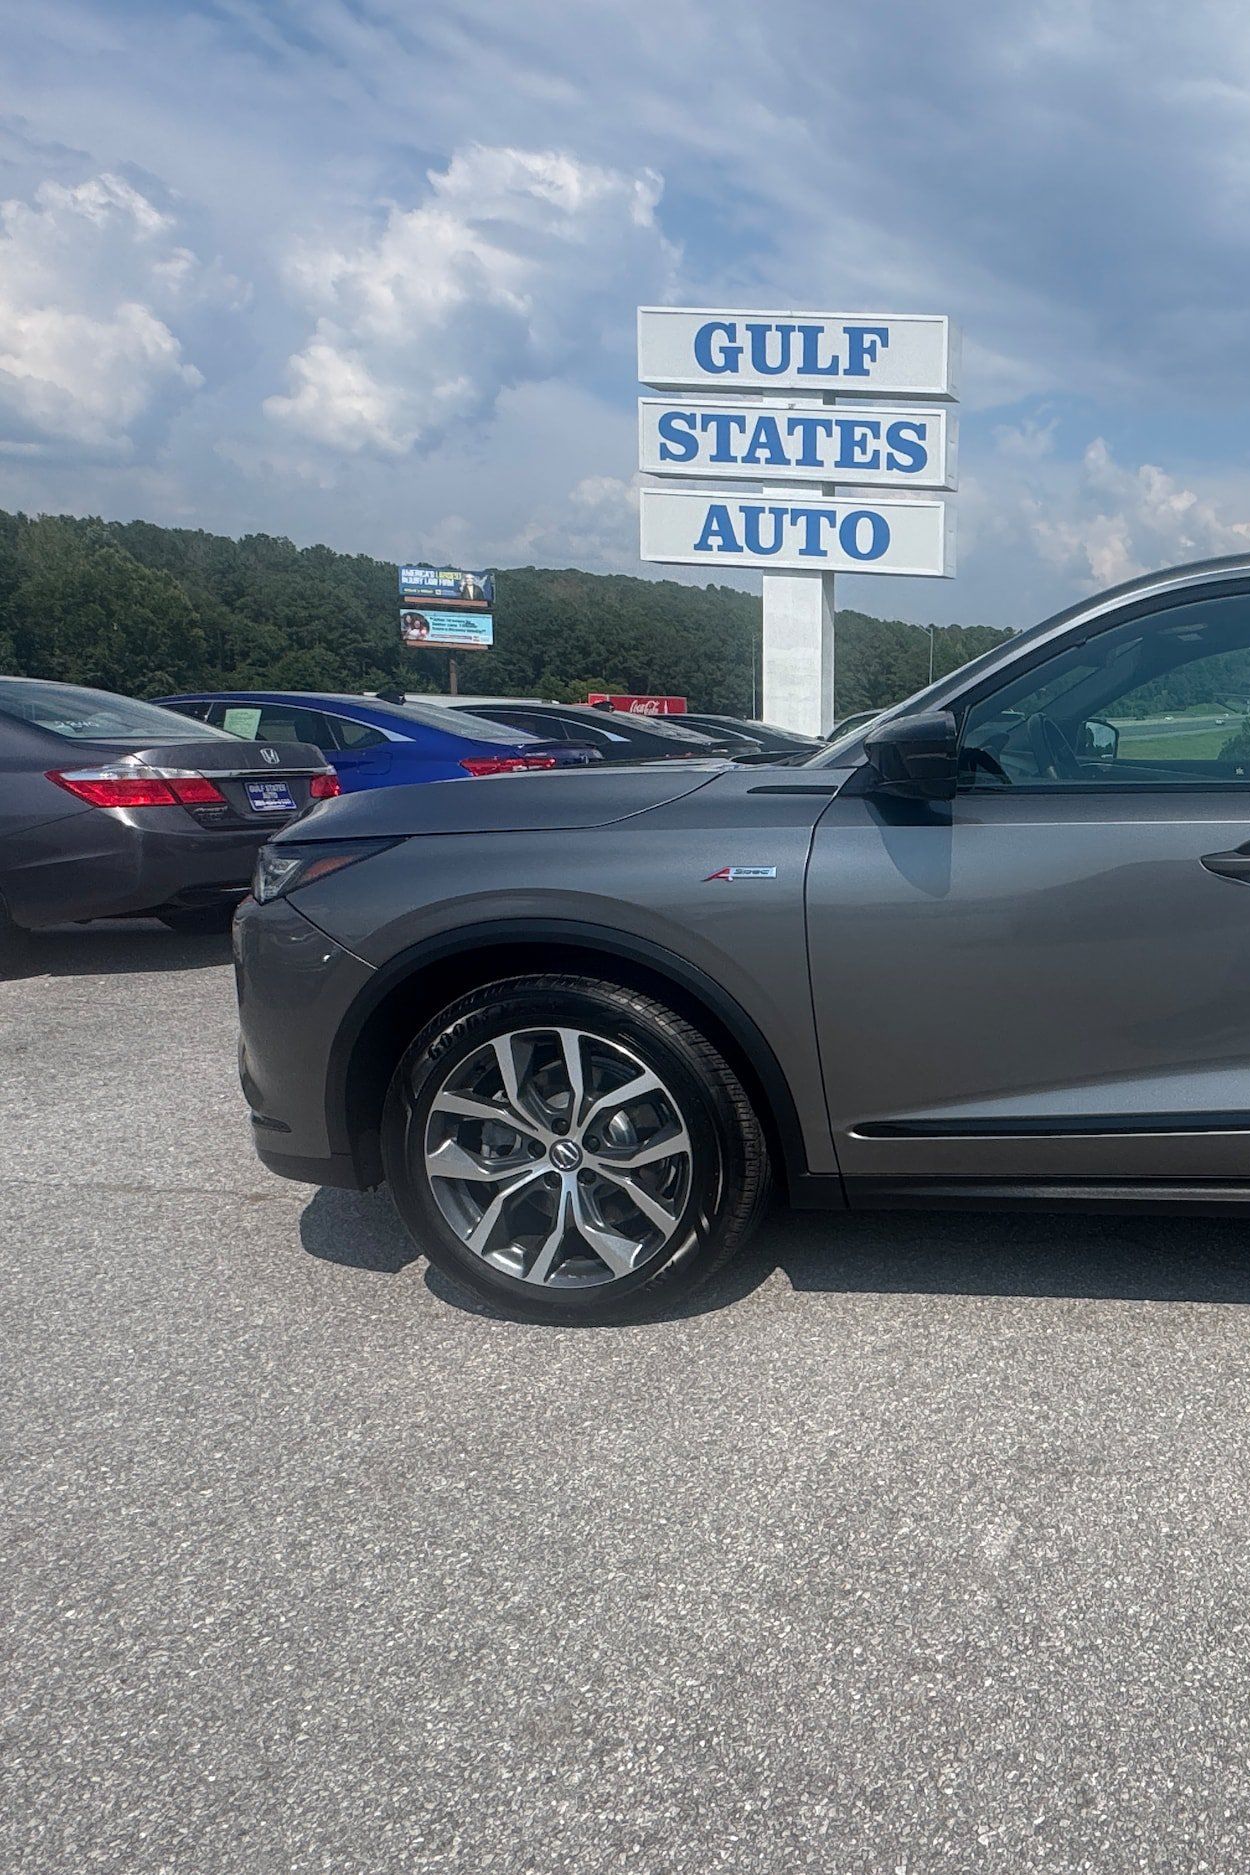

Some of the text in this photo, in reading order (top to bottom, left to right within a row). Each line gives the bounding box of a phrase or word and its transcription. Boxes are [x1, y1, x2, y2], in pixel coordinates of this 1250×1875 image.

[693, 321, 889, 377] GULF
[657, 410, 928, 474] STATES
[693, 503, 891, 561] AUTO
